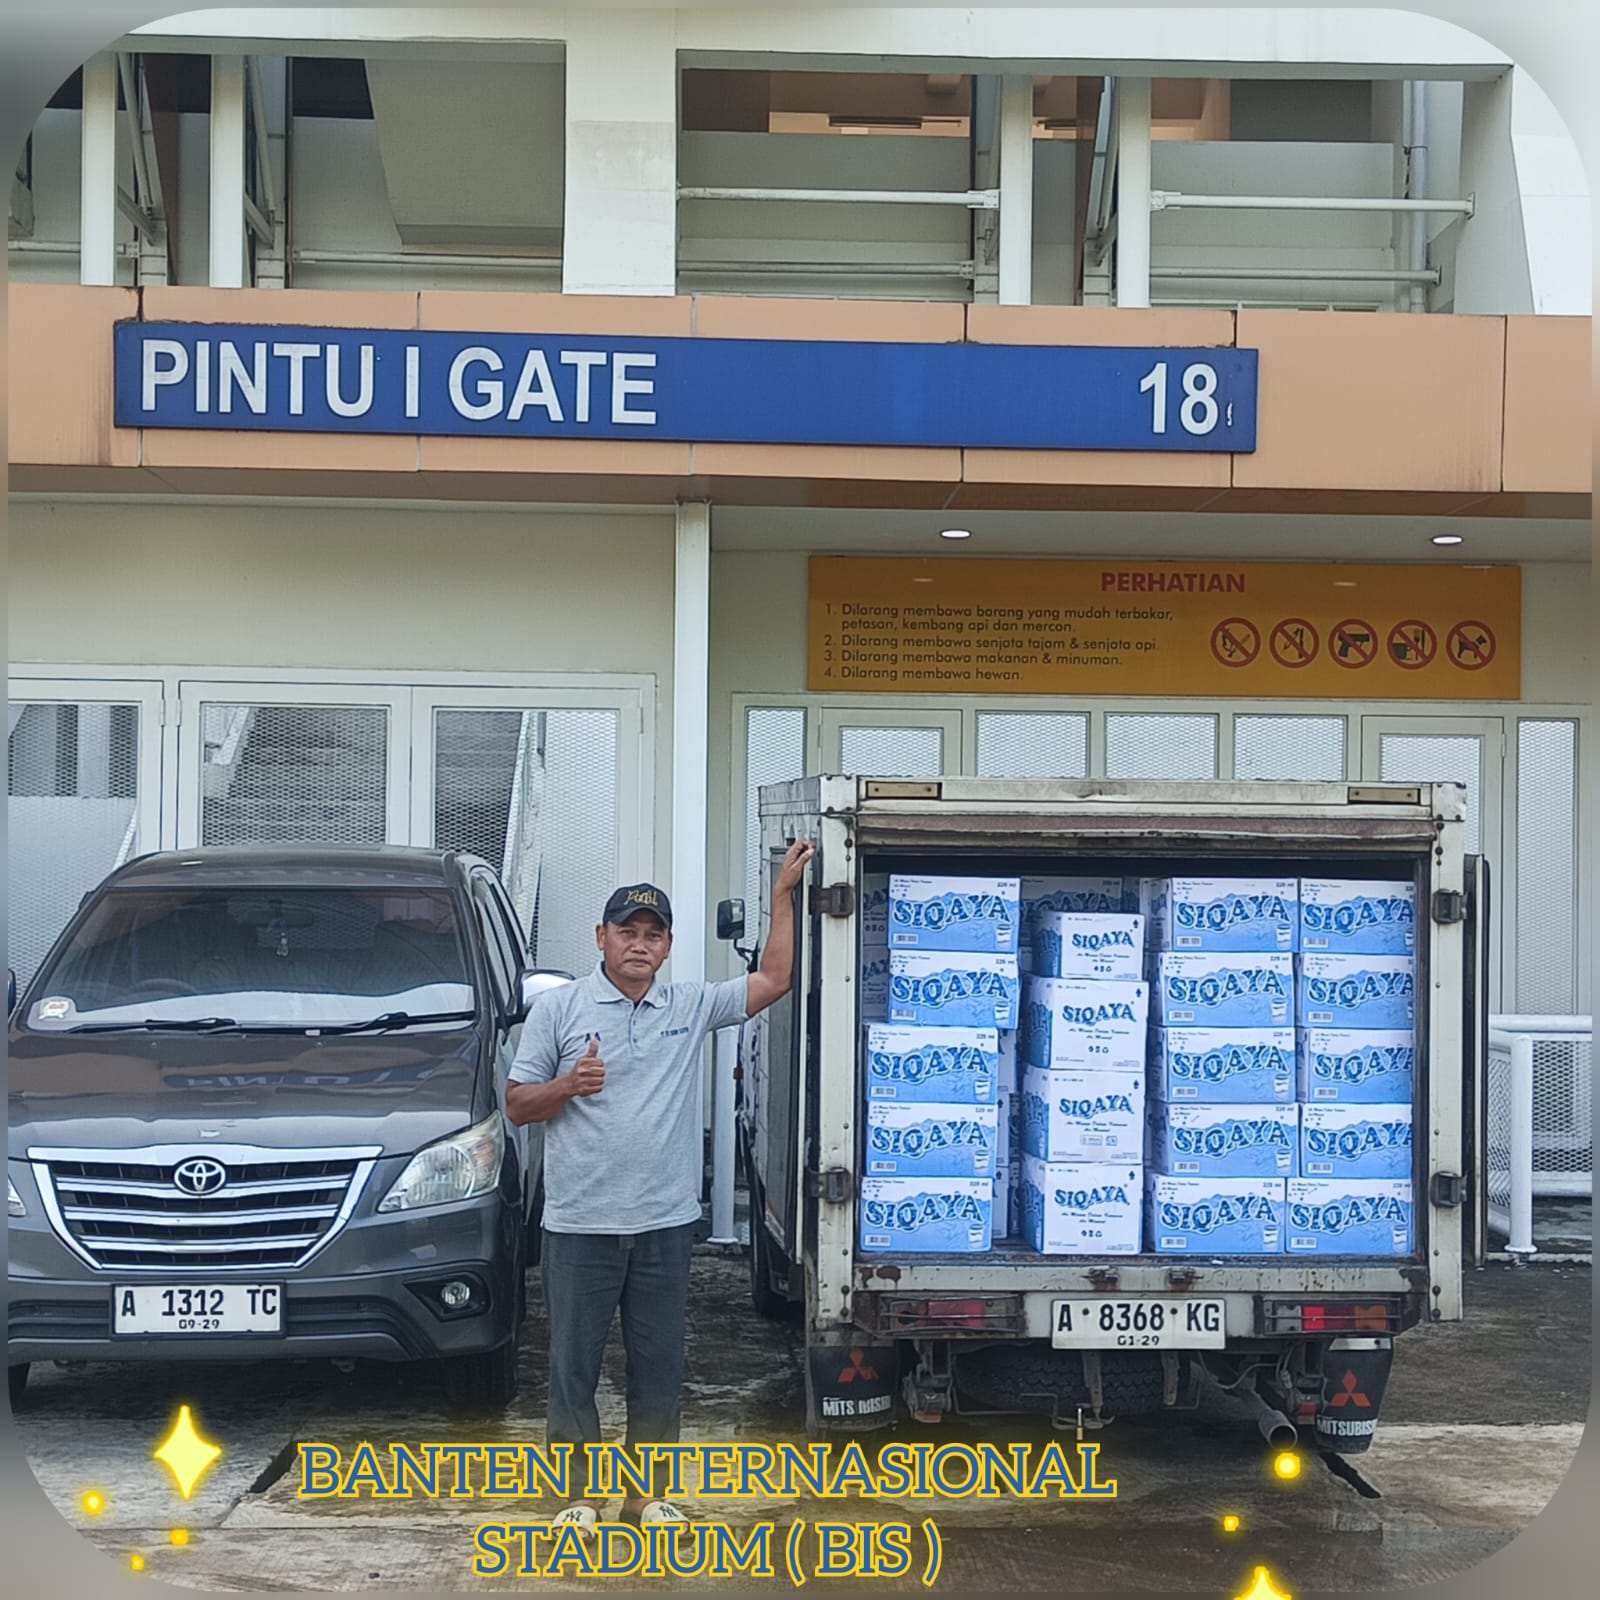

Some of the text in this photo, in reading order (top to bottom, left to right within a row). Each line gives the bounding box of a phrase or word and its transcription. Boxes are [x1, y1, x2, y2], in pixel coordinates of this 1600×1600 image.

[142, 339, 374, 417] PINTU
[448, 346, 657, 425] GATE
[1140, 363, 1218, 435] 18
[1101, 572, 1246, 592] PERHATIAN
[841, 619, 1076, 633] petasan, kembang api dan mercon.
[842, 604, 898, 618] Dilarang
[903, 605, 972, 617] membawa
[977, 605, 1023, 620] barang
[1028, 609, 1060, 621] yang
[1064, 607, 1110, 619] mudah
[1115, 609, 1173, 621] terbakar,
[842, 635, 898, 649] Dilarang
[903, 635, 971, 648] membawa
[976, 636, 1023, 650] senjata
[1028, 638, 1065, 651] tajam
[1070, 638, 1079, 649] &
[1083, 638, 1131, 652] senjata
[842, 650, 898, 664] Dilarang
[902, 651, 971, 663] membawa
[976, 652, 1037, 664] makanan
[1042, 653, 1052, 664] &
[1056, 654, 1122, 665] minuman.
[842, 667, 897, 681] Dilarang
[902, 667, 971, 680] membawa
[976, 668, 1023, 680] hewan.
[893, 894, 1011, 930] SIQAYA
[1176, 895, 1290, 931] SIQAYA
[1304, 898, 1413, 935] SIQAYA
[1071, 931, 1135, 950] SIQAYA
[892, 971, 1009, 1007] SIQAYA
[1168, 969, 1286, 1006] SIQAYA
[1062, 1003, 1136, 1026] SIQAYA
[872, 1046, 989, 1082] SIQAYA
[1173, 1045, 1288, 1082] SIQAYA
[1059, 1095, 1134, 1120] SIQAYA
[872, 1121, 988, 1157] SIQAYA
[1174, 1120, 1290, 1157] SIQAYA
[865, 1194, 983, 1231] SIQAYA
[1054, 1186, 1130, 1210] SIQAYA
[1161, 1196, 1278, 1233] SIQAYA
[1291, 1197, 1408, 1234] SIQAYA
[121, 1288, 277, 1317] A 1312 TC
[1057, 1303, 1220, 1332] A 8368 KG
